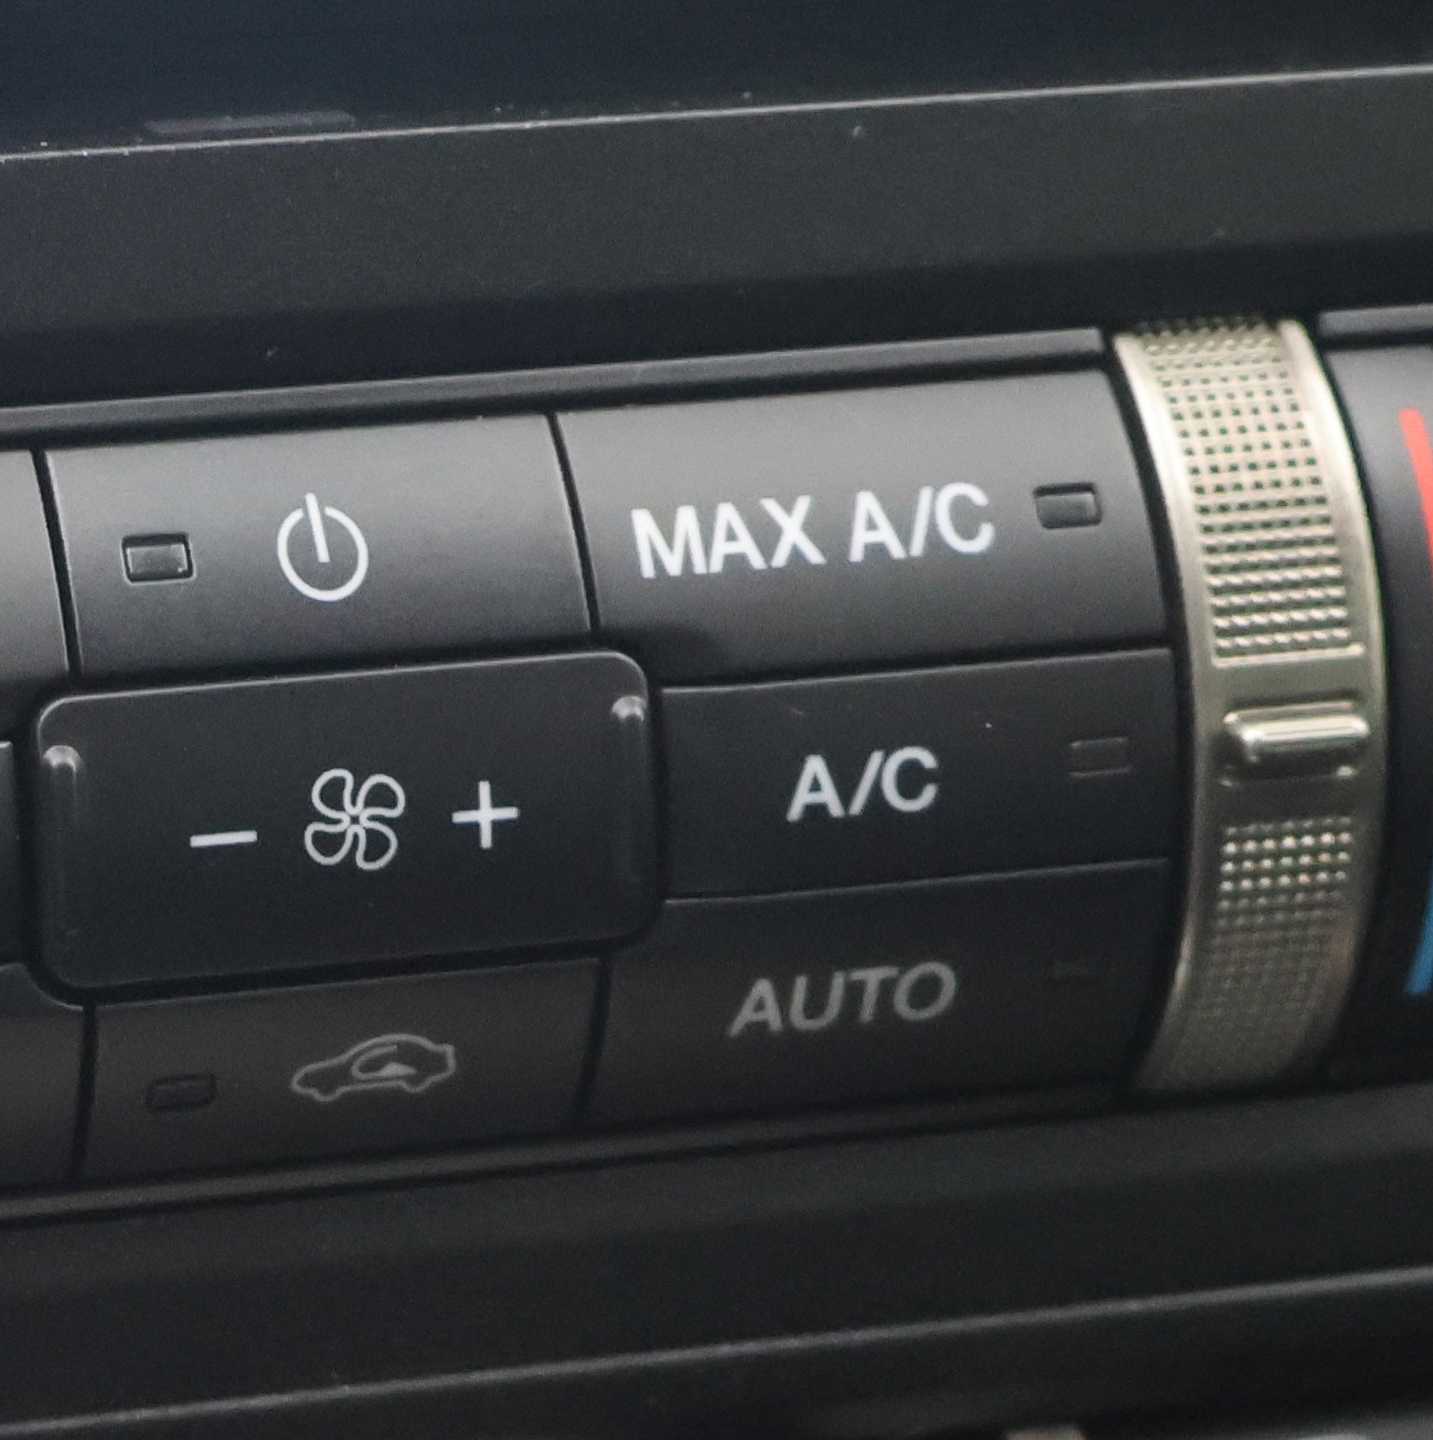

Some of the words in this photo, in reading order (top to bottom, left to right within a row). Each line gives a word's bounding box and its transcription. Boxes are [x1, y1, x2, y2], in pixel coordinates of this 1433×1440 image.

[630, 494, 826, 579] MAX
[848, 481, 995, 562] A/C
[786, 745, 940, 822] A/C
[728, 960, 957, 1038] AUTO
